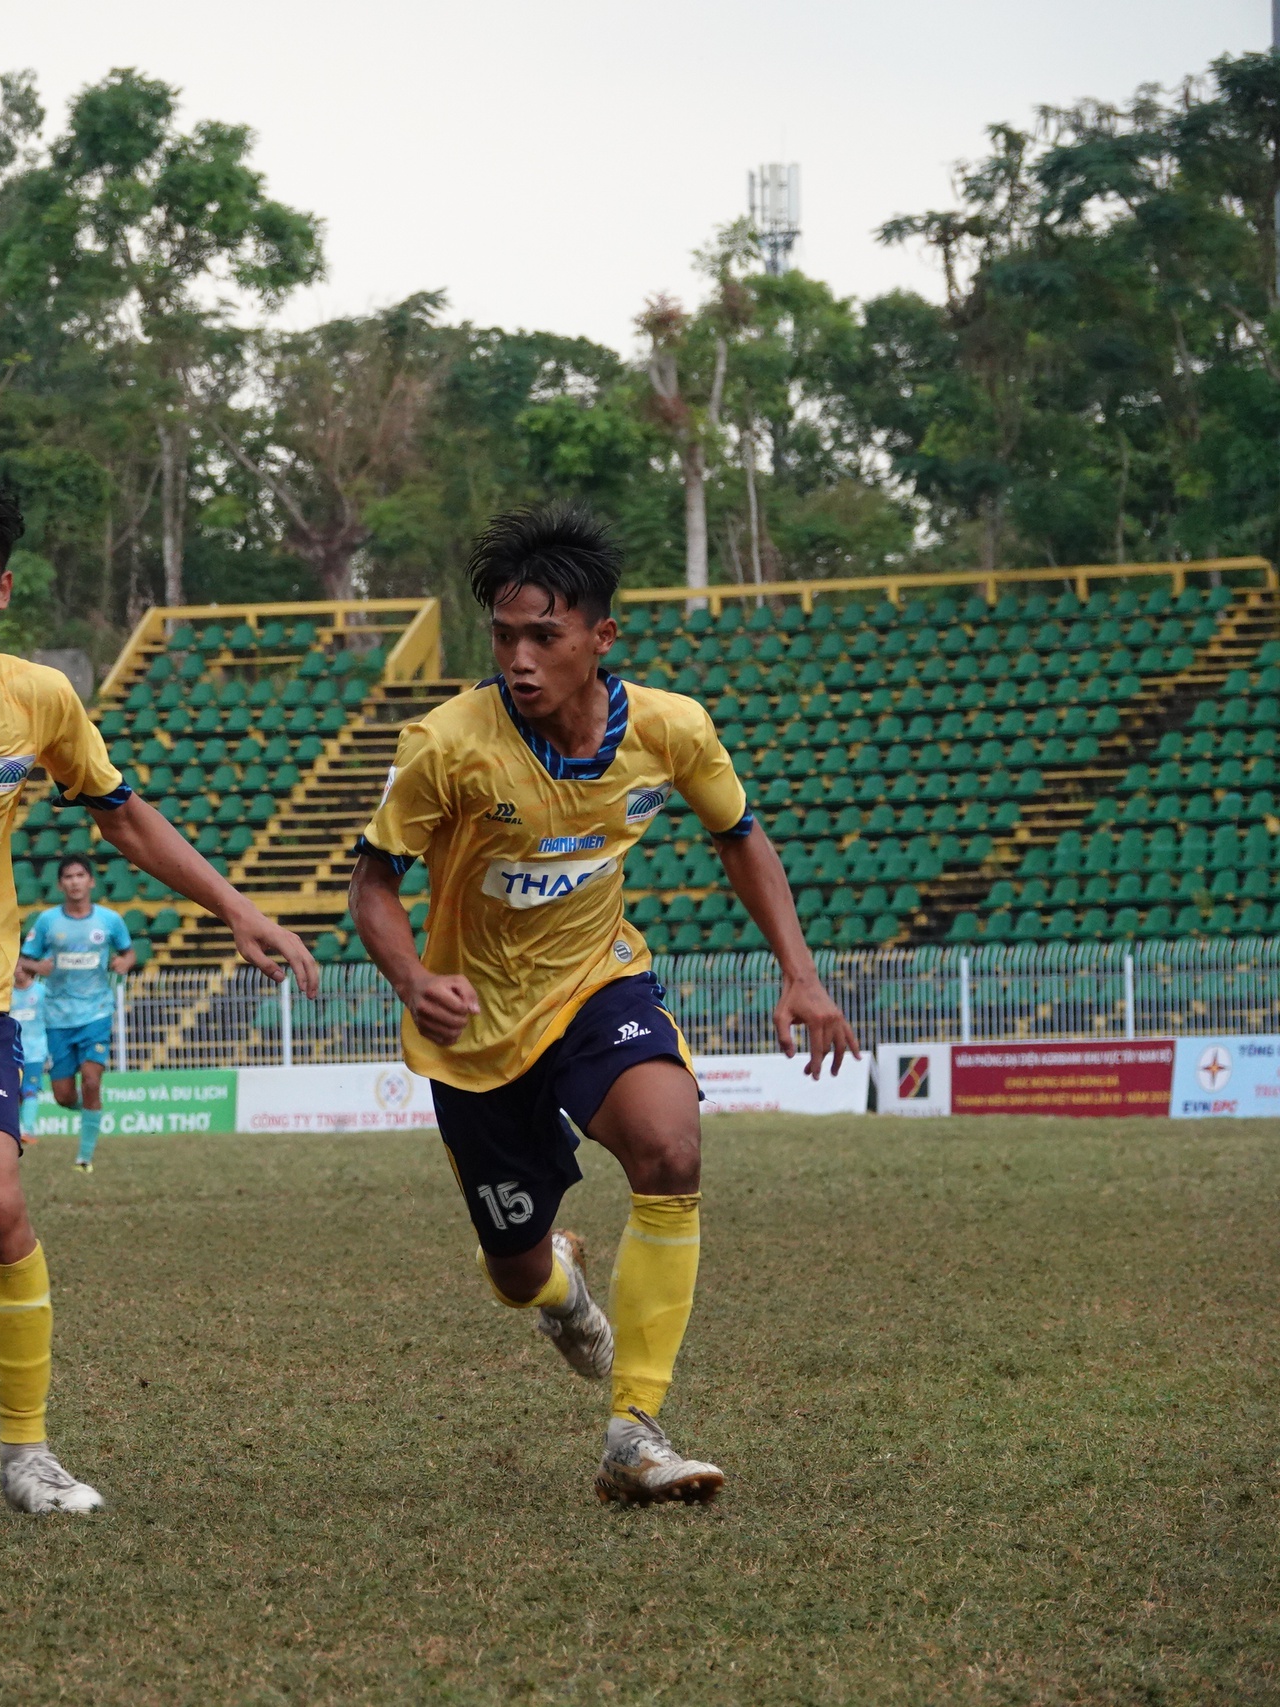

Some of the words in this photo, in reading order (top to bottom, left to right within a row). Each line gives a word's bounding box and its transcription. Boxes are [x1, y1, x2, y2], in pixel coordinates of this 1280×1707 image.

[538, 836, 578, 853] THANH
[107, 1086, 147, 1102] THAO
[148, 1083, 170, 1102] VÀ
[119, 1109, 164, 1133] CẦN
[167, 1111, 212, 1132] THƠ
[251, 1111, 290, 1129] CÔNG
[292, 1113, 312, 1128] TY
[477, 1180, 534, 1230] 15
